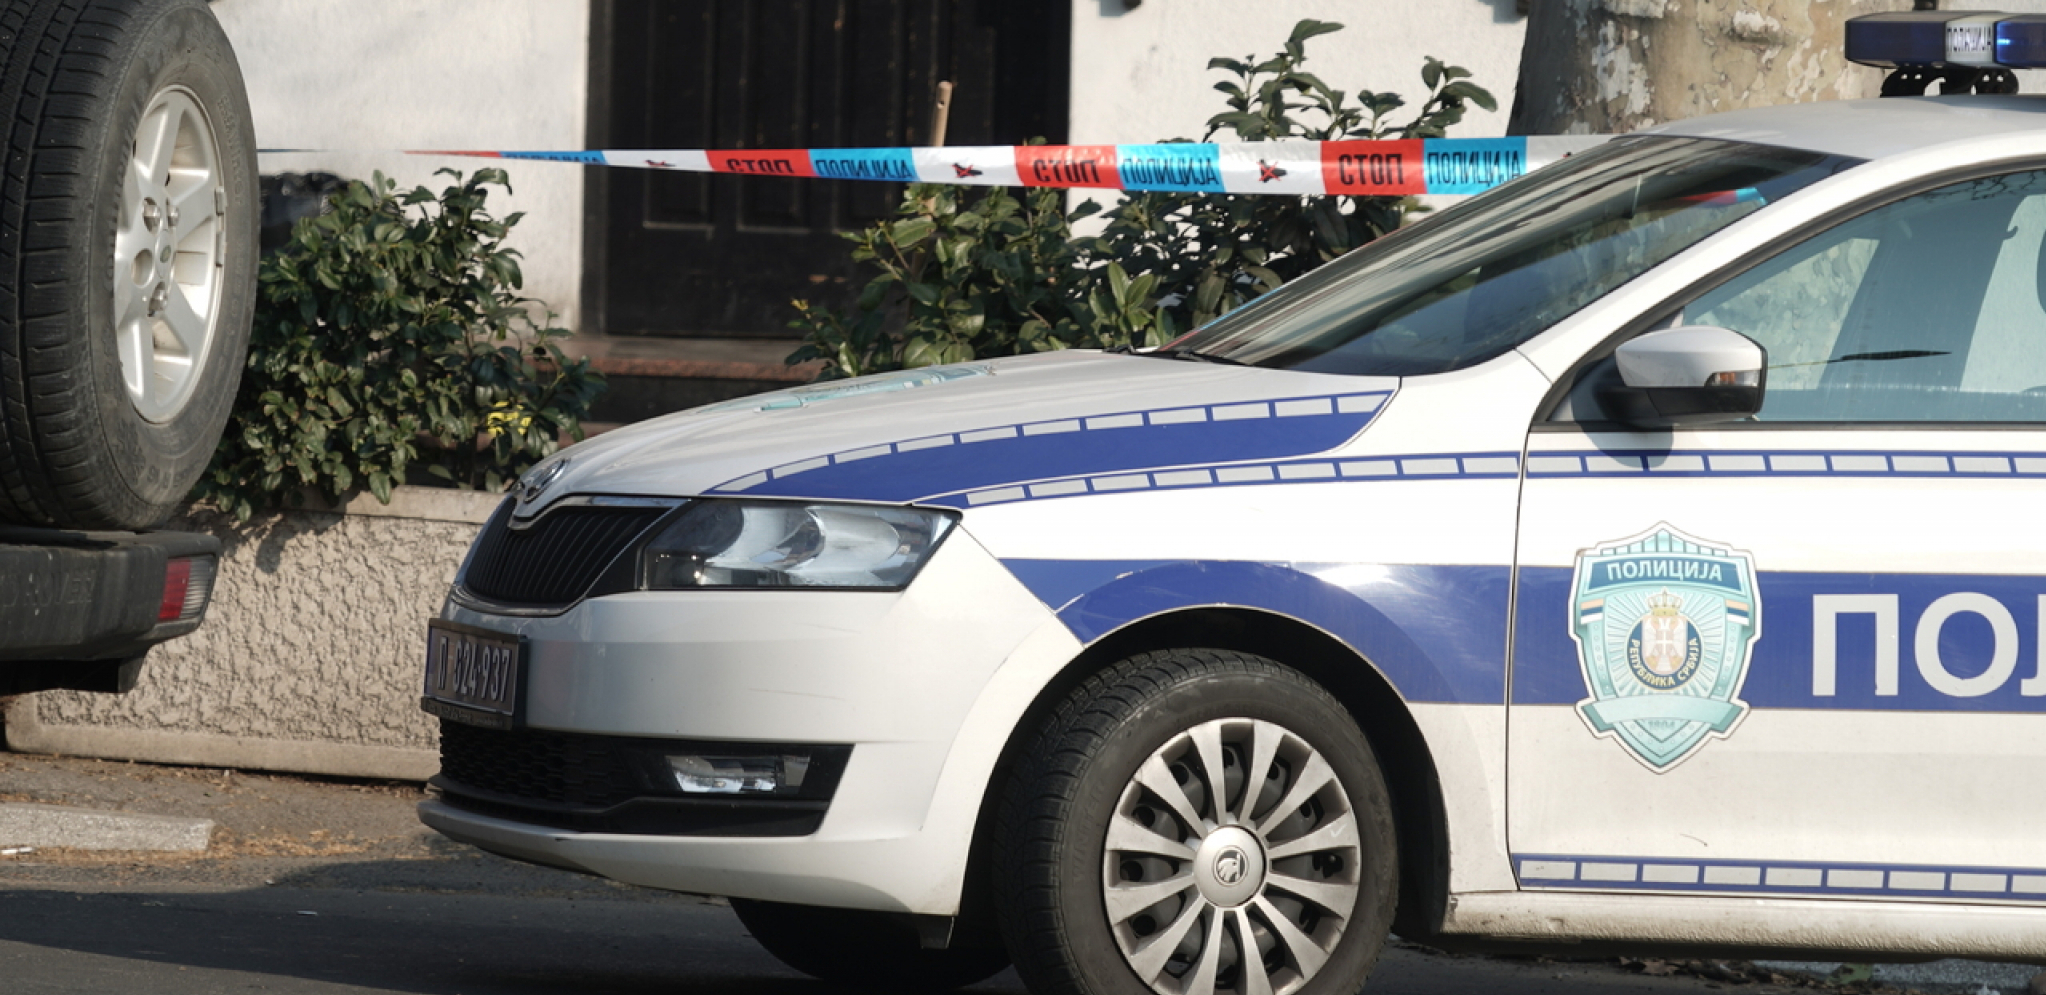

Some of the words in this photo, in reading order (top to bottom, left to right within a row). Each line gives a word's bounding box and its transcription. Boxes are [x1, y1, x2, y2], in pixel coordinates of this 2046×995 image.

[1033, 158, 1101, 184] СТОП
[1122, 157, 1219, 186] ПОЛИЦИЈА
[1338, 153, 1404, 186] СТОП
[1427, 150, 1522, 187] ПОЛИЦИЈА
[1606, 559, 1723, 582] ПОЛИЦИЈА
[1629, 638, 1676, 687] РЕПУБЛИКА
[1677, 637, 1700, 681] СРБИЈА
[1812, 591, 2046, 698] ПО
